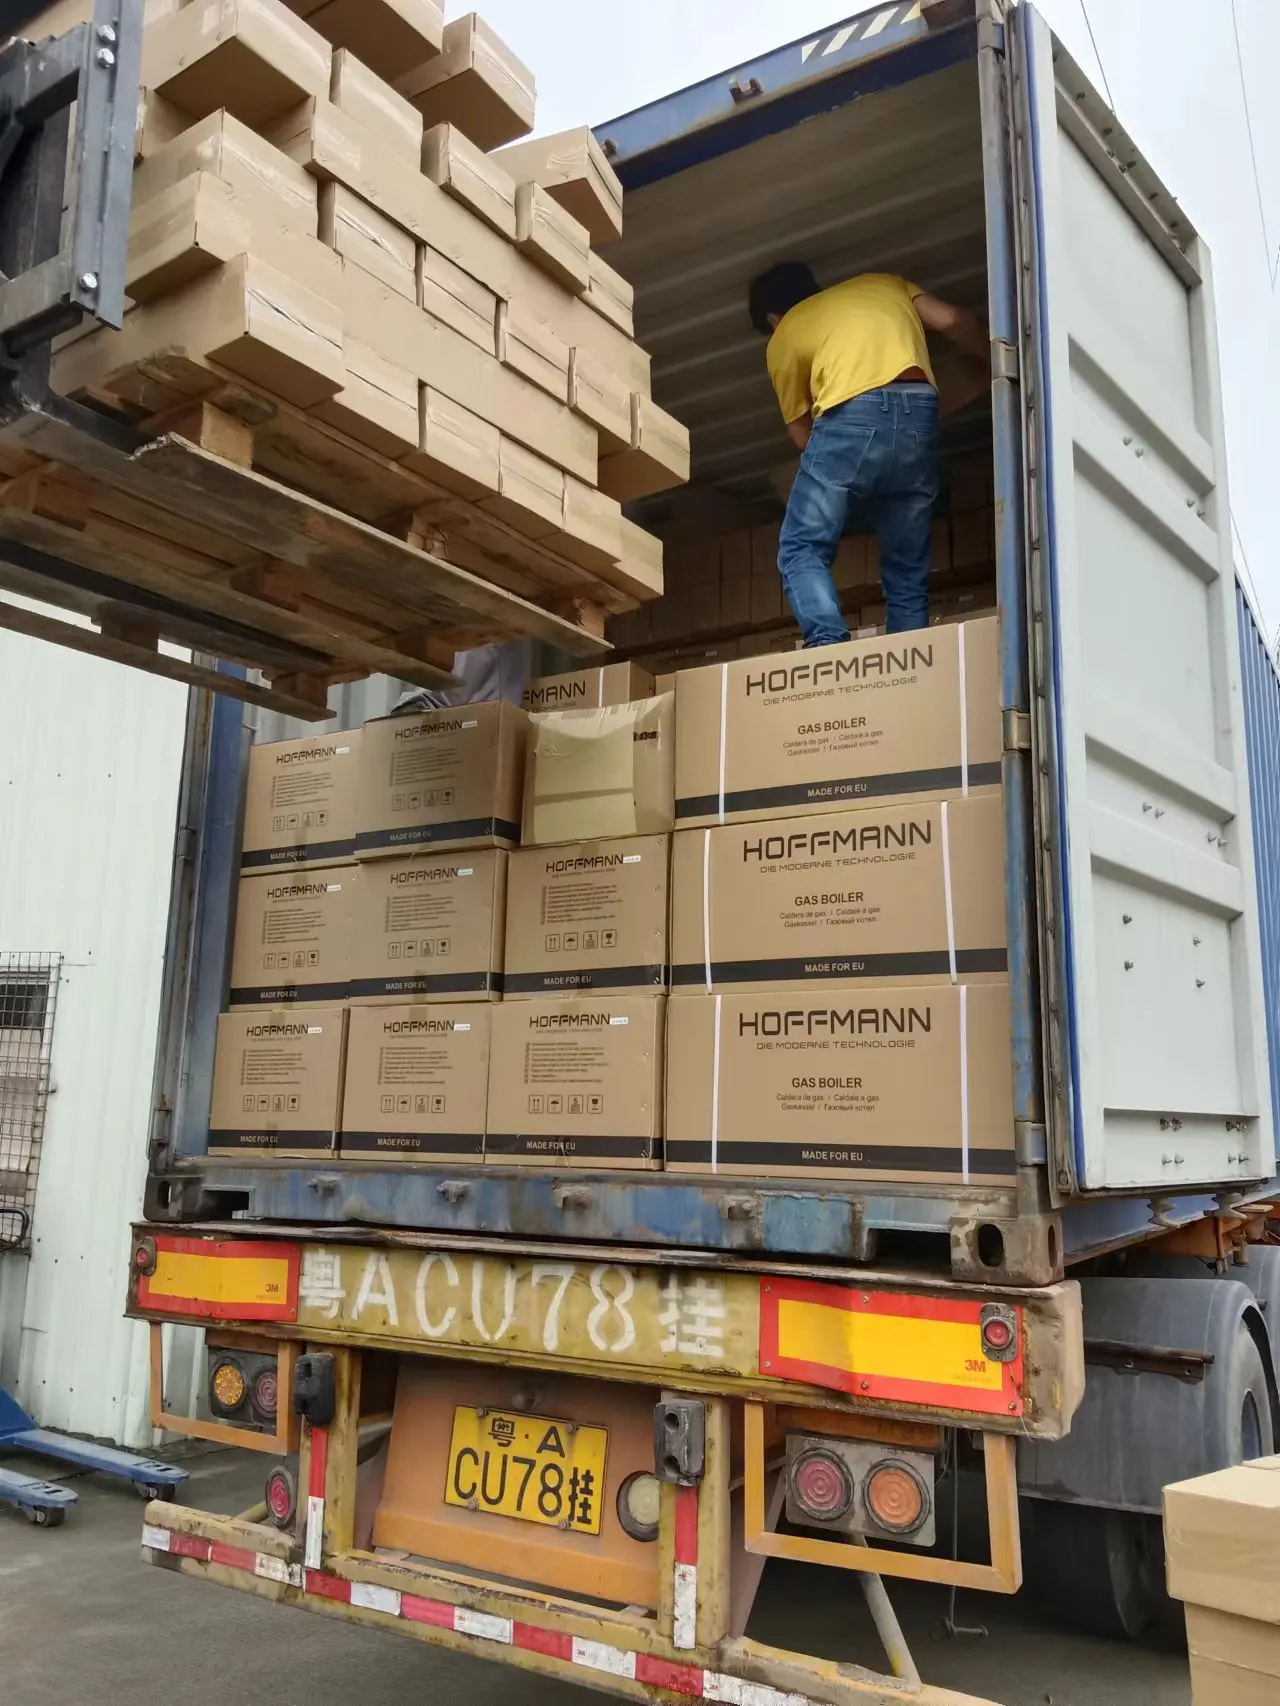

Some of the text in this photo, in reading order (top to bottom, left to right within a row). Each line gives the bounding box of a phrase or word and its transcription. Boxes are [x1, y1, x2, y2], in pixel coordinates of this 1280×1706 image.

[746, 644, 934, 696] HOFFMANN
[763, 676, 918, 706] DIE MODERNE TECHNOLOGIE
[395, 719, 463, 740] HOFFMANN
[797, 716, 867, 735] GAS BOILER
[818, 738, 829, 746] gas
[870, 730, 883, 738] gas
[276, 746, 338, 765] HOFFMANN
[807, 782, 867, 798] MADE FOR EU
[743, 820, 932, 862] HOFFMANN
[545, 853, 624, 873] HOFFMANN
[760, 852, 916, 874] DIE MODERNE TECHNOLOGIE
[390, 867, 459, 884] HOFFMANN
[267, 882, 328, 899] HOFFMANN
[794, 891, 864, 906] GAS BOILER
[814, 910, 826, 919] gas
[868, 906, 881, 915] gas
[804, 961, 865, 973] MADE FOR EU
[385, 982, 403, 990] MADE
[404, 981, 417, 990] FOR
[544, 975, 591, 985] MADE FOR EU
[383, 1020, 455, 1033] HOFFMANN
[529, 1013, 610, 1028] HOFFMANN
[739, 1006, 931, 1037] HOFFMANN
[246, 1024, 309, 1037] HOFFMANN
[757, 1039, 916, 1050] DIE MODERNE TECHNOLOGIE
[791, 1077, 862, 1088] GAS BOILER
[803, 1093, 811, 1101] de
[812, 1095, 824, 1103] gas
[866, 1095, 879, 1103] gas
[240, 1135, 256, 1143] MADE
[257, 1135, 269, 1143] FOR
[377, 1138, 420, 1147] MADE FOR EU
[526, 1140, 576, 1150] MADE FOR EU
[801, 1150, 863, 1161] MADE FOR EU
[265, 1283, 279, 1293] 3M
[964, 1359, 986, 1373] 3M
[454, 1447, 594, 1525] CU78挂
